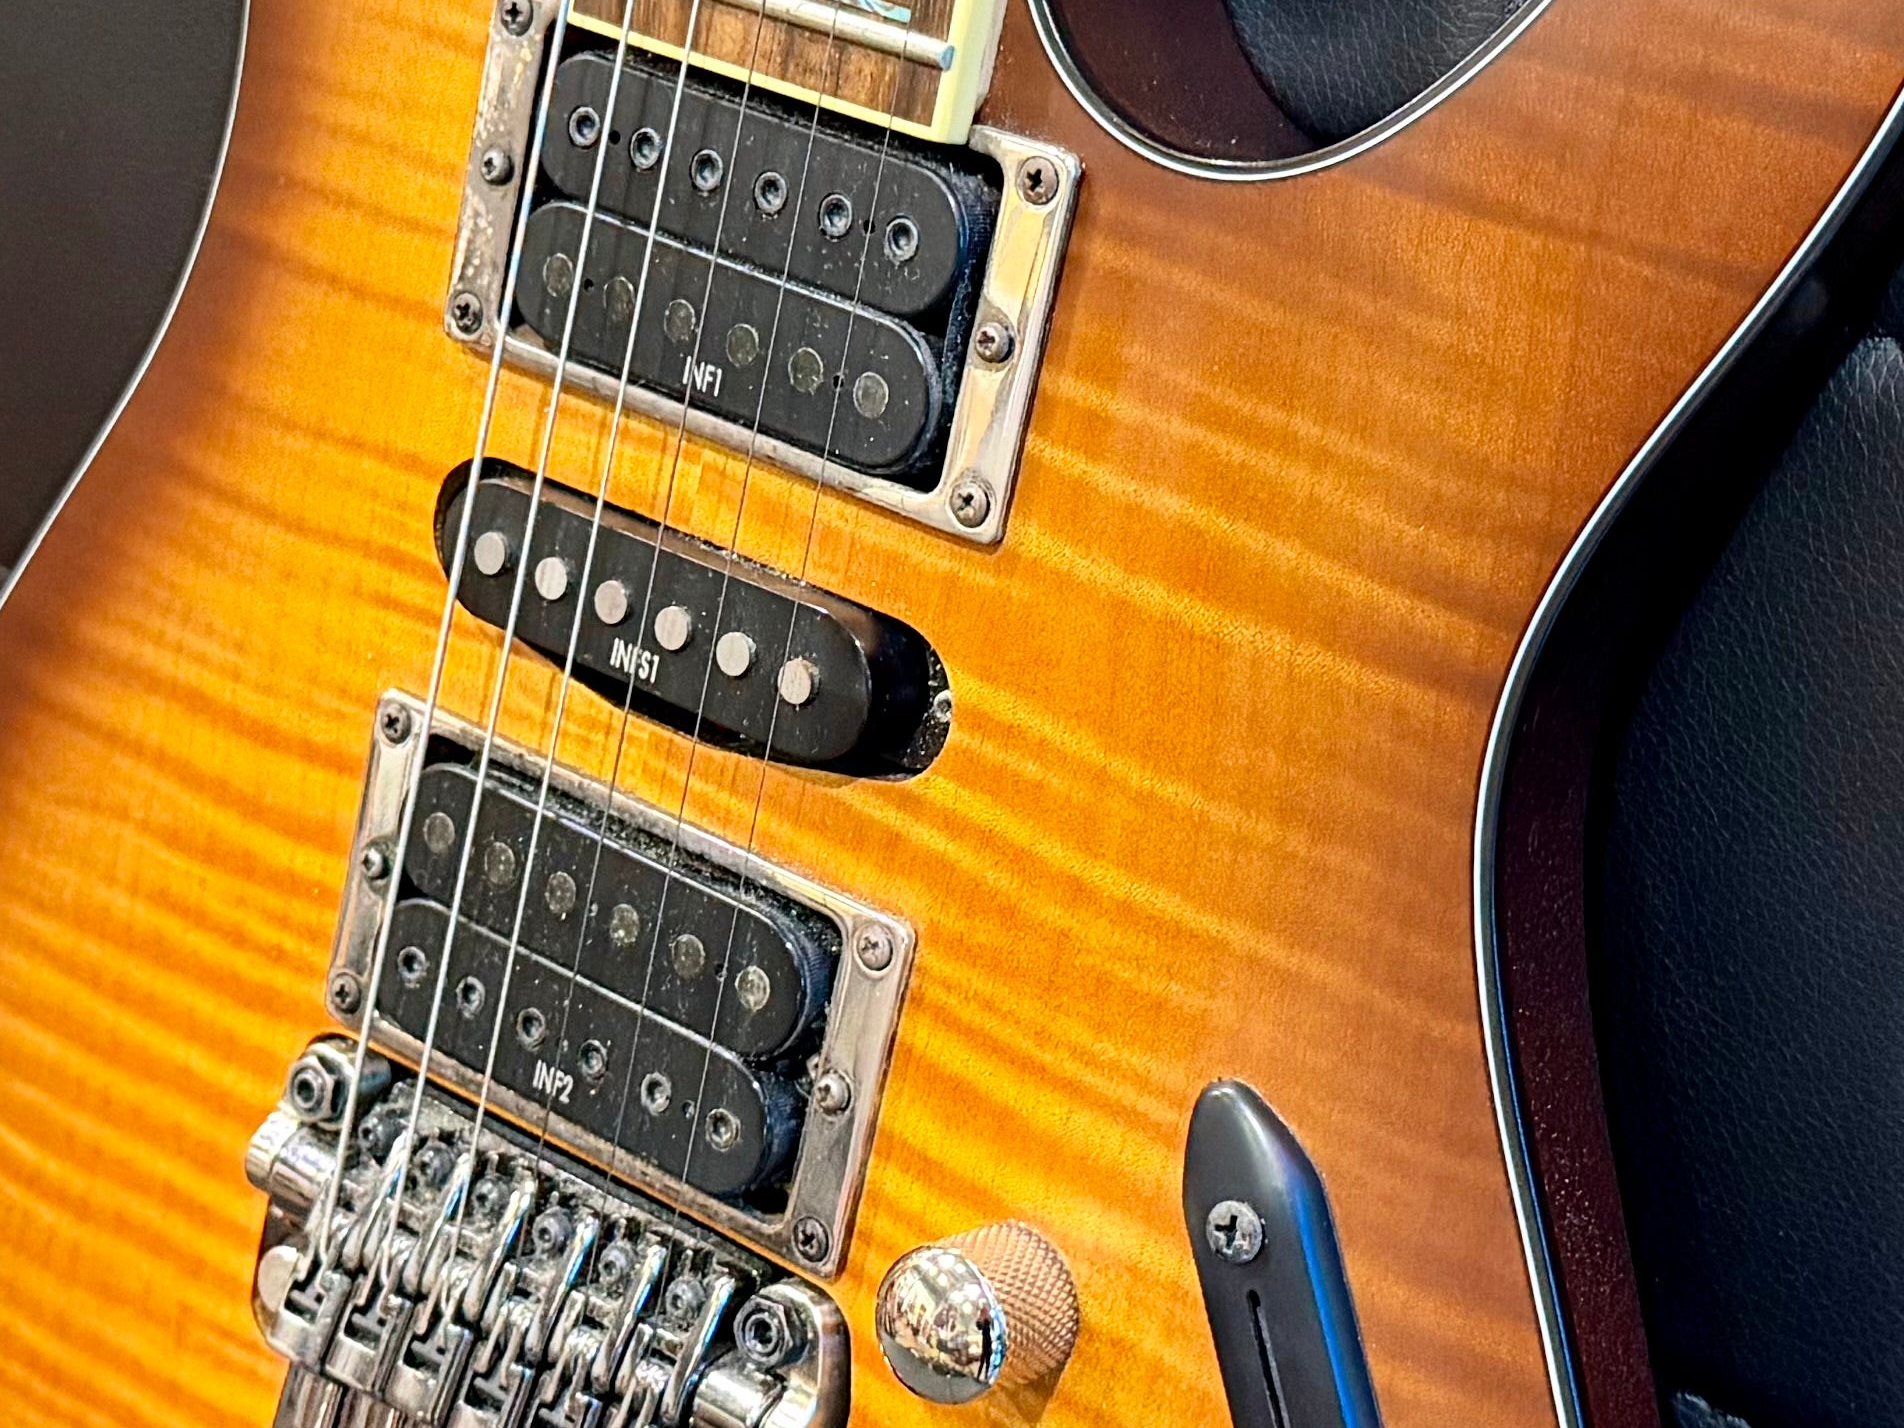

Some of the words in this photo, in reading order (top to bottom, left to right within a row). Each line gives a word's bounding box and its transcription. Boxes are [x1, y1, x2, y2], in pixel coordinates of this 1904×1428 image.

[681, 354, 723, 397] INF1
[610, 637, 660, 684] INFS1
[531, 1058, 574, 1105] INF2
